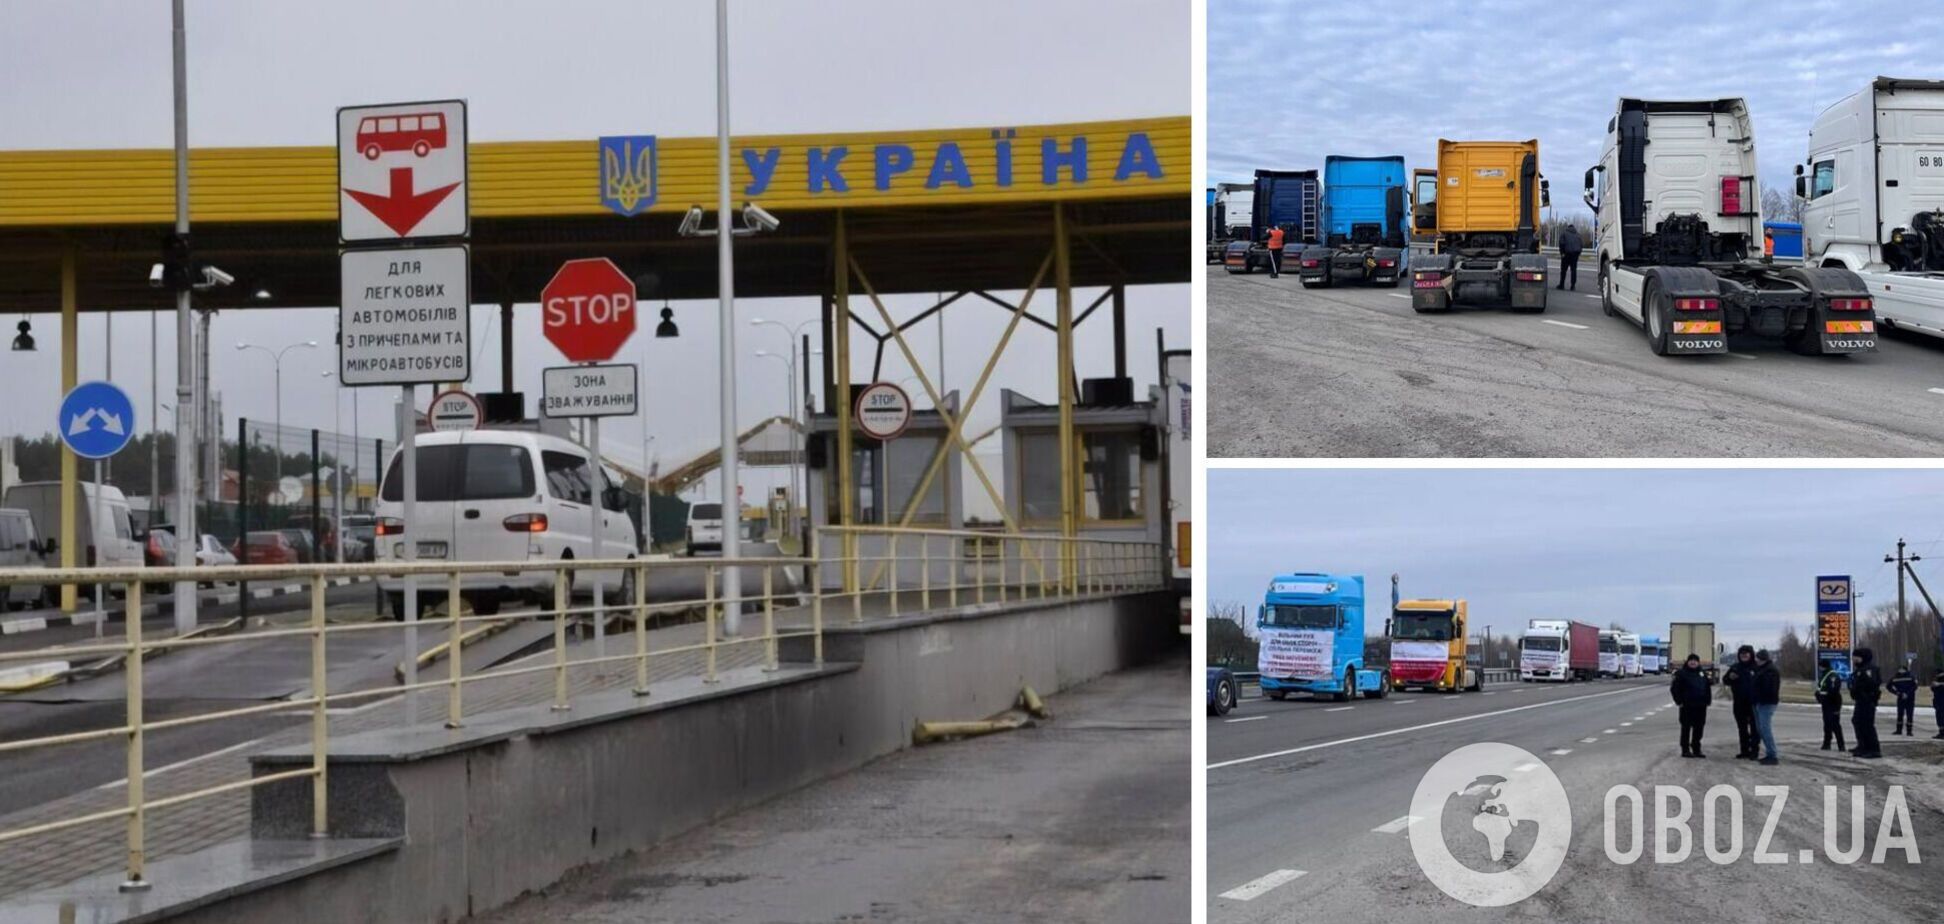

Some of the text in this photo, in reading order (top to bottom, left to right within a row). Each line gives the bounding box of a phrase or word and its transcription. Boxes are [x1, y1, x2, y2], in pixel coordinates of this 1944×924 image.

[741, 128, 1165, 196] УКРАЇНА
[387, 261, 422, 277] ДЛЯ
[364, 284, 445, 300] ЛЕГКОВИХ
[352, 307, 457, 325] АВТОМОБІЛІВ
[546, 293, 631, 327] STOP
[347, 331, 463, 348] З ПРИЧЕПАМИ ТА
[1673, 340, 1723, 349] VOLVO
[1828, 340, 1875, 349] VOLVO
[347, 355, 464, 372] МІКРОАВТОБУСІВ
[573, 375, 606, 388] ЗОНА
[443, 400, 468, 412] STOP
[547, 393, 634, 409] ЗВАЖУВАННЯ
[871, 394, 896, 405] STOP
